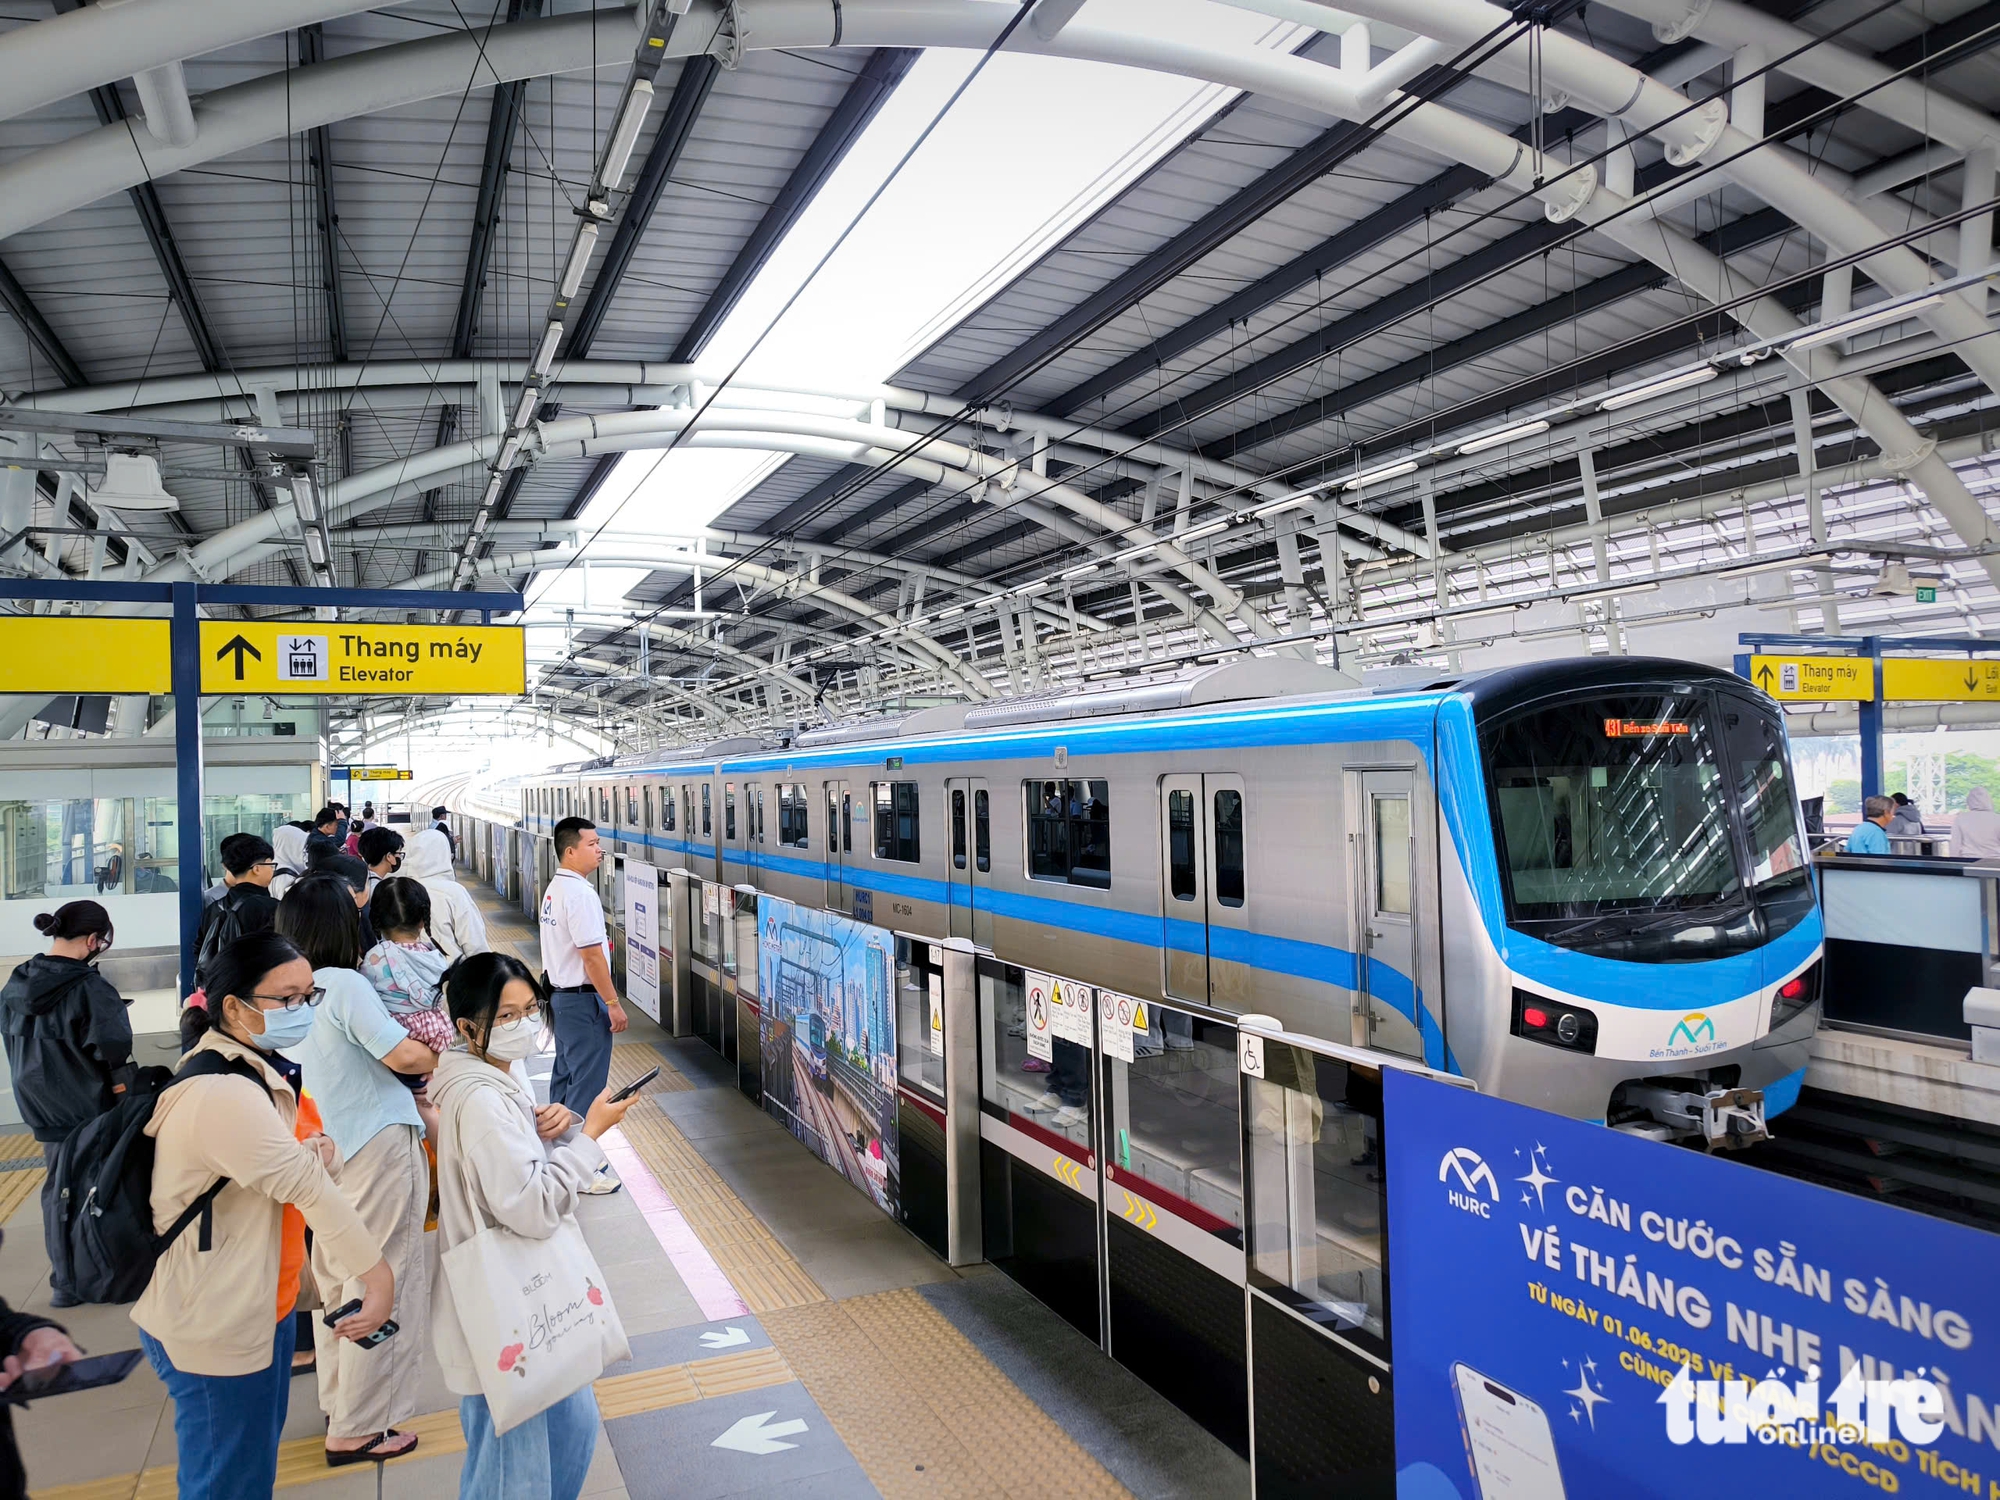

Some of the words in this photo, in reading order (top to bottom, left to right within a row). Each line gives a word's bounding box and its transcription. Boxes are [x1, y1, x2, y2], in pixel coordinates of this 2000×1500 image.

[339, 635, 420, 663] Thang
[430, 637, 483, 663] máy
[339, 666, 414, 681] Elevator
[1802, 664, 1833, 680] Thang
[1836, 664, 1857, 680] máy
[1802, 683, 1831, 693] Elevator
[1448, 1189, 1491, 1219] HURC
[1518, 1222, 1561, 1271] VÉ
[1569, 1241, 1712, 1329] THÁNG
[1565, 1184, 1631, 1232] CĂN
[1639, 1210, 1743, 1270] CƯỚC
[1753, 1240, 1831, 1303] SẴN
[1843, 1276, 1973, 1350] SÀNG
[528, 1298, 584, 1350] Bloom
[547, 1325, 572, 1353] your
[574, 1311, 594, 1326] way
[1527, 1281, 1548, 1305] TỪ
[1551, 1291, 1599, 1327] NGÀY
[1603, 1315, 1704, 1373] 01.06.2025
[1915, 1448, 1981, 1496] TÍCH
[1619, 1351, 1676, 1390] CÙNG
